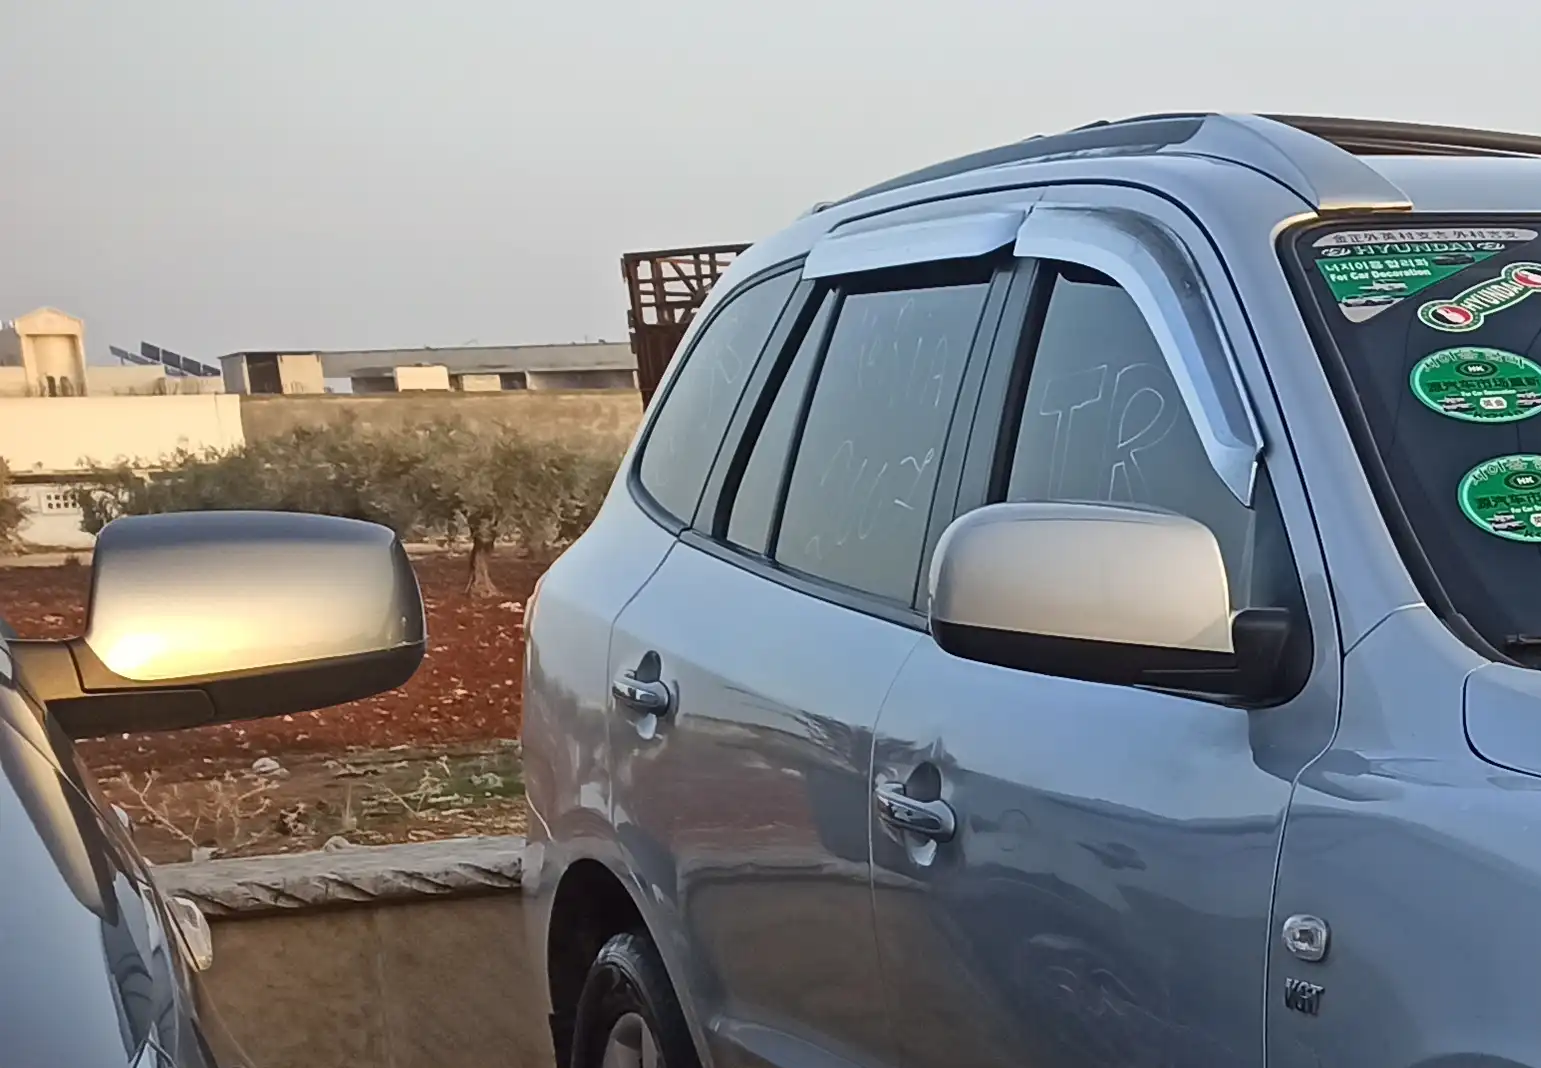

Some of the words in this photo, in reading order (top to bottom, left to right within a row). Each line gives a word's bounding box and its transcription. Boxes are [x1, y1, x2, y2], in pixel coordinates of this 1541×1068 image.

[1353, 241, 1477, 255] HYUNDAI
[1329, 273, 1348, 282] For
[1350, 271, 1369, 280] Car
[1370, 268, 1432, 279] Decoration
[1462, 281, 1524, 311] HYUNDAI
